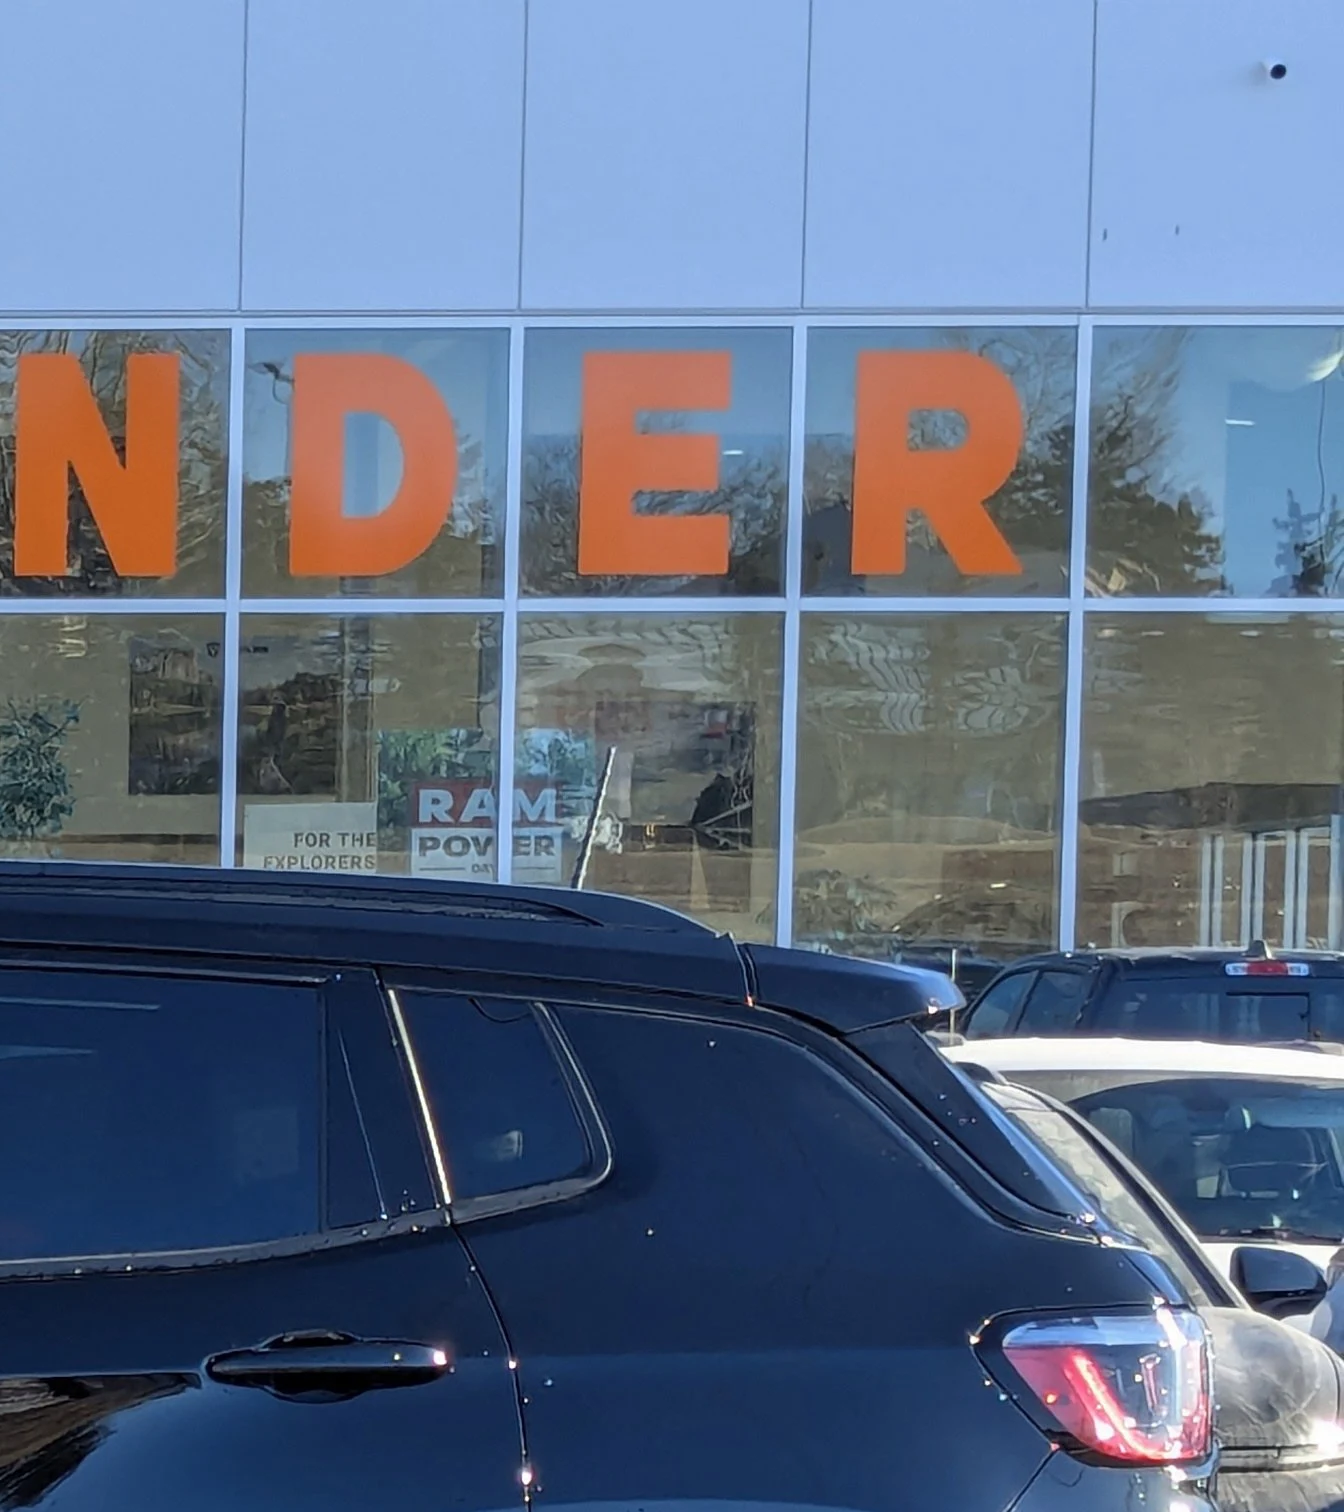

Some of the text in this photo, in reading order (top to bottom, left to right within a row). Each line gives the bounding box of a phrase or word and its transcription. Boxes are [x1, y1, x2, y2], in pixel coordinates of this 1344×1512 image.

[418, 788, 556, 823] RAM
[293, 832, 377, 848] FOR THE
[263, 854, 376, 870] EXPLORERS
